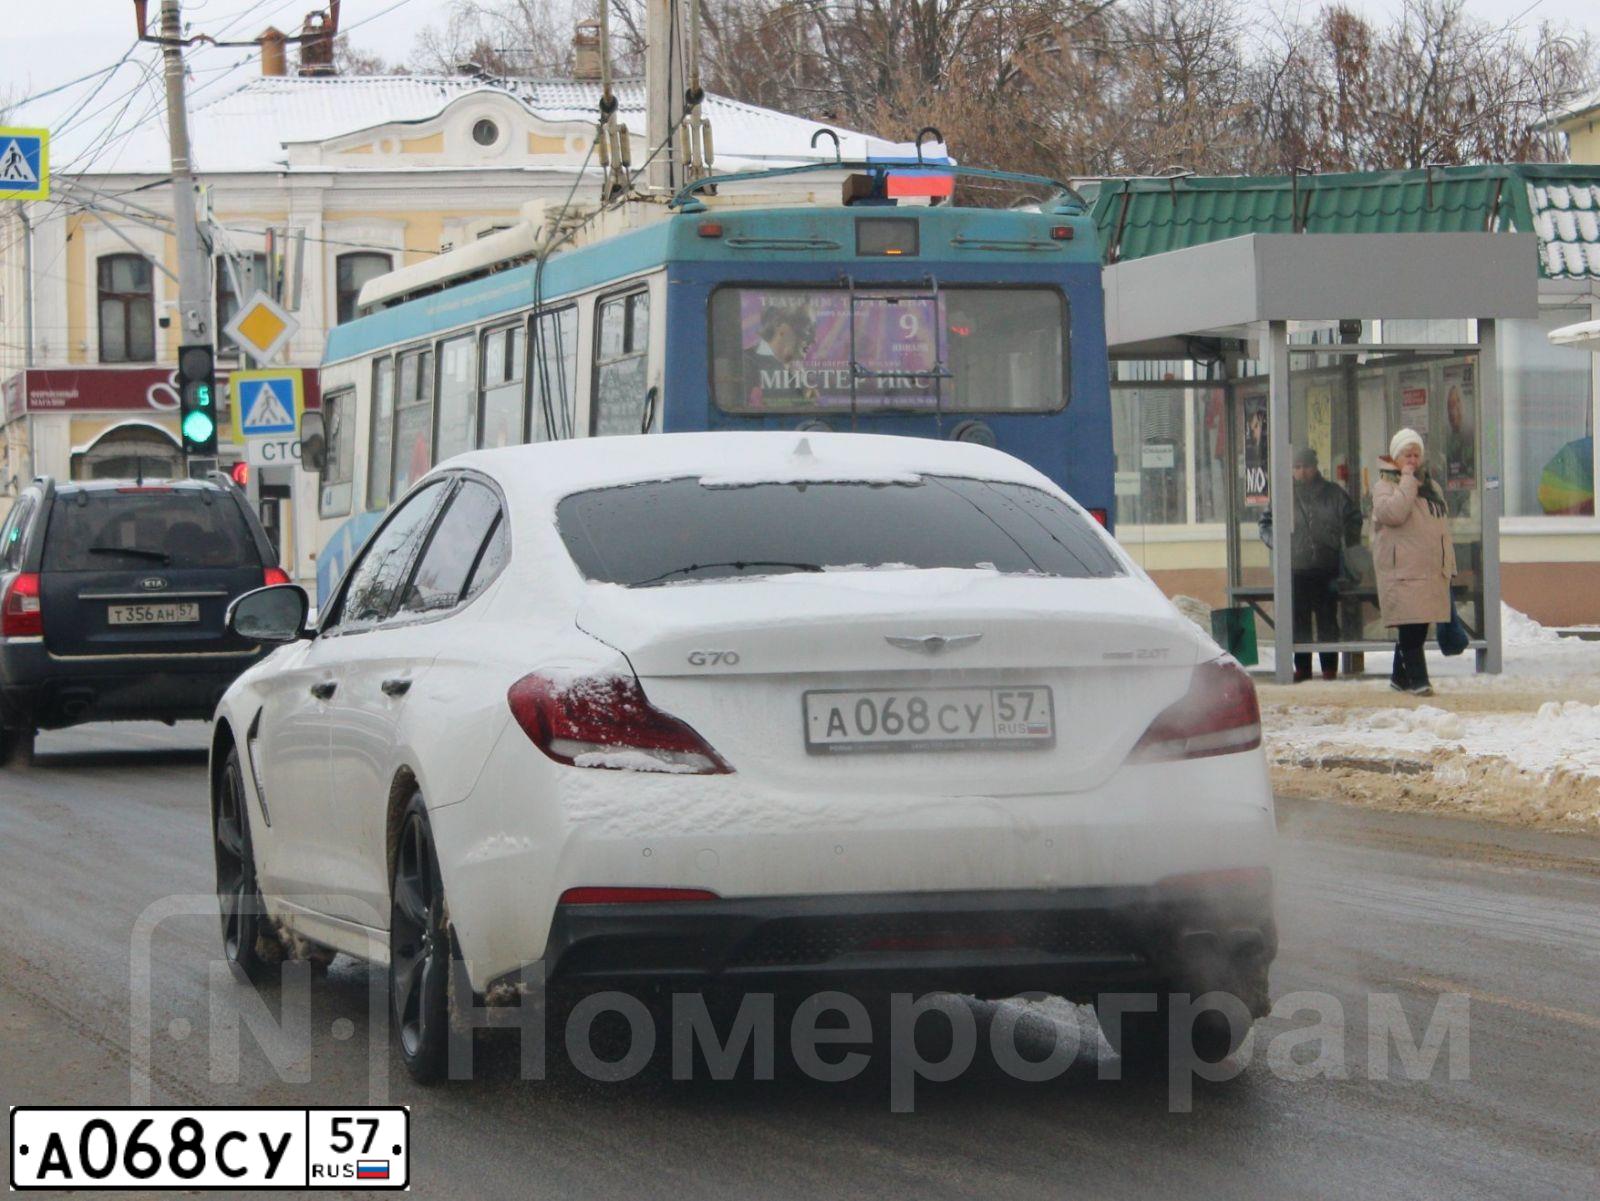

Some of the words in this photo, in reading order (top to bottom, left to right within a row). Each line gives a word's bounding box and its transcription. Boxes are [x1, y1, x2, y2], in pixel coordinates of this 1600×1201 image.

[899, 314, 919, 339] 9
[760, 369, 866, 389] МИСТЕР
[197, 385, 210, 406] 5
[262, 440, 302, 461] СТО
[688, 651, 740, 666] G70
[826, 696, 984, 737] А068СУ
[998, 692, 1034, 722] 57
[998, 723, 1026, 734] RUS
